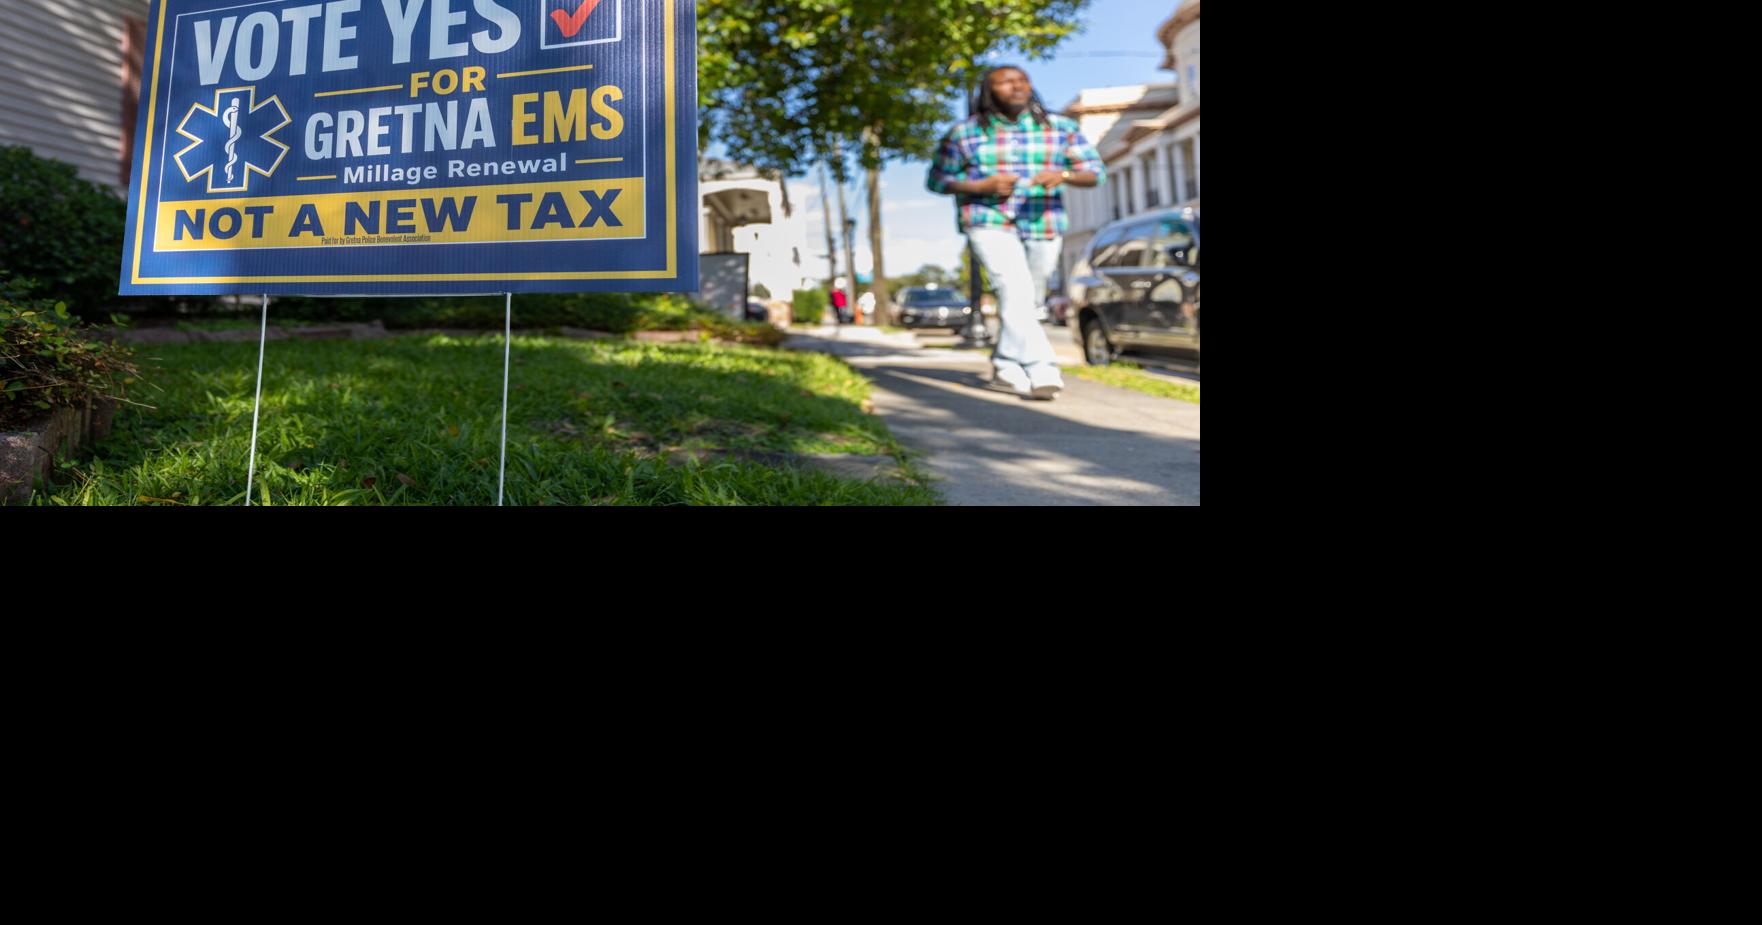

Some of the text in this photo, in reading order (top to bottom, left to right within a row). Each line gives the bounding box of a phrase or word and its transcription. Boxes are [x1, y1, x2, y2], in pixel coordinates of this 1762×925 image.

[194, 0, 521, 86] VOTE YES
[409, 66, 486, 98] FOR
[304, 85, 625, 161] GRETNA EMS
[343, 153, 567, 185] Millage Renewal
[173, 188, 624, 241] NOT A NEW TAX
[321, 234, 431, 245] Paid for by Gretna Police Benevolent Association
